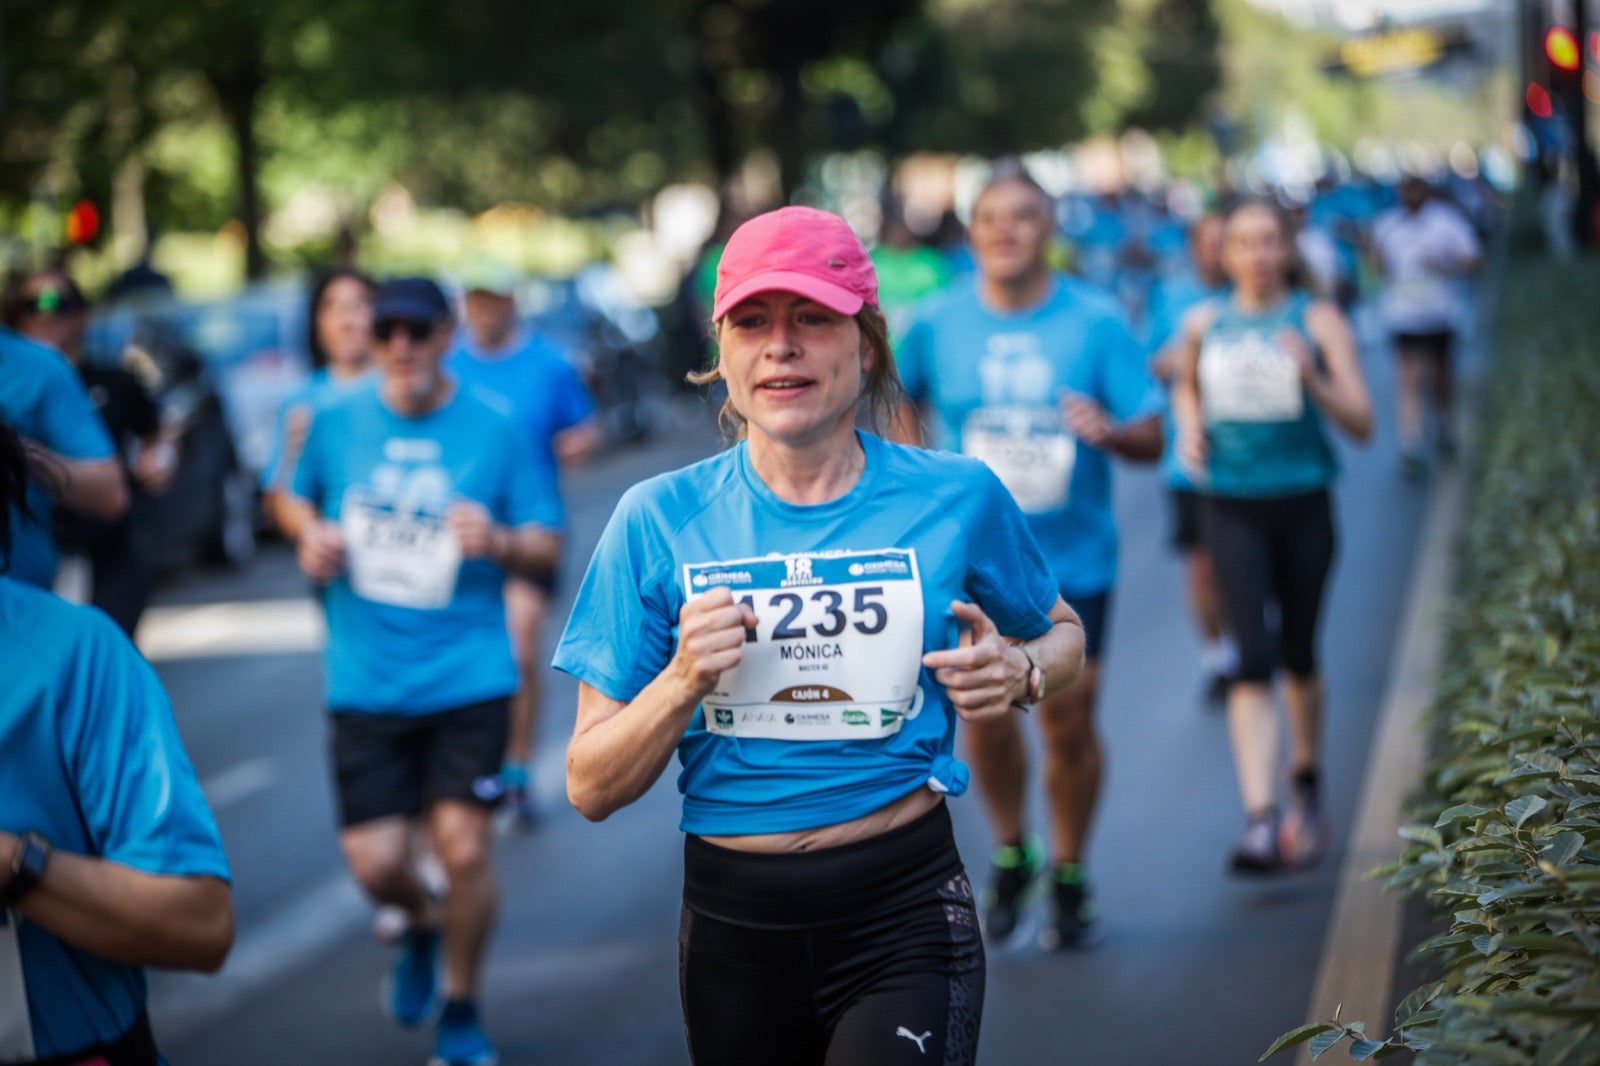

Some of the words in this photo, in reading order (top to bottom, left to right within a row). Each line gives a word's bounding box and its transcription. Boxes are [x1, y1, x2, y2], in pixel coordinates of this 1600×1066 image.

[780, 642, 843, 660] MÓNICA
[792, 687, 820, 700] CAJÓN
[822, 688, 829, 699] 4
